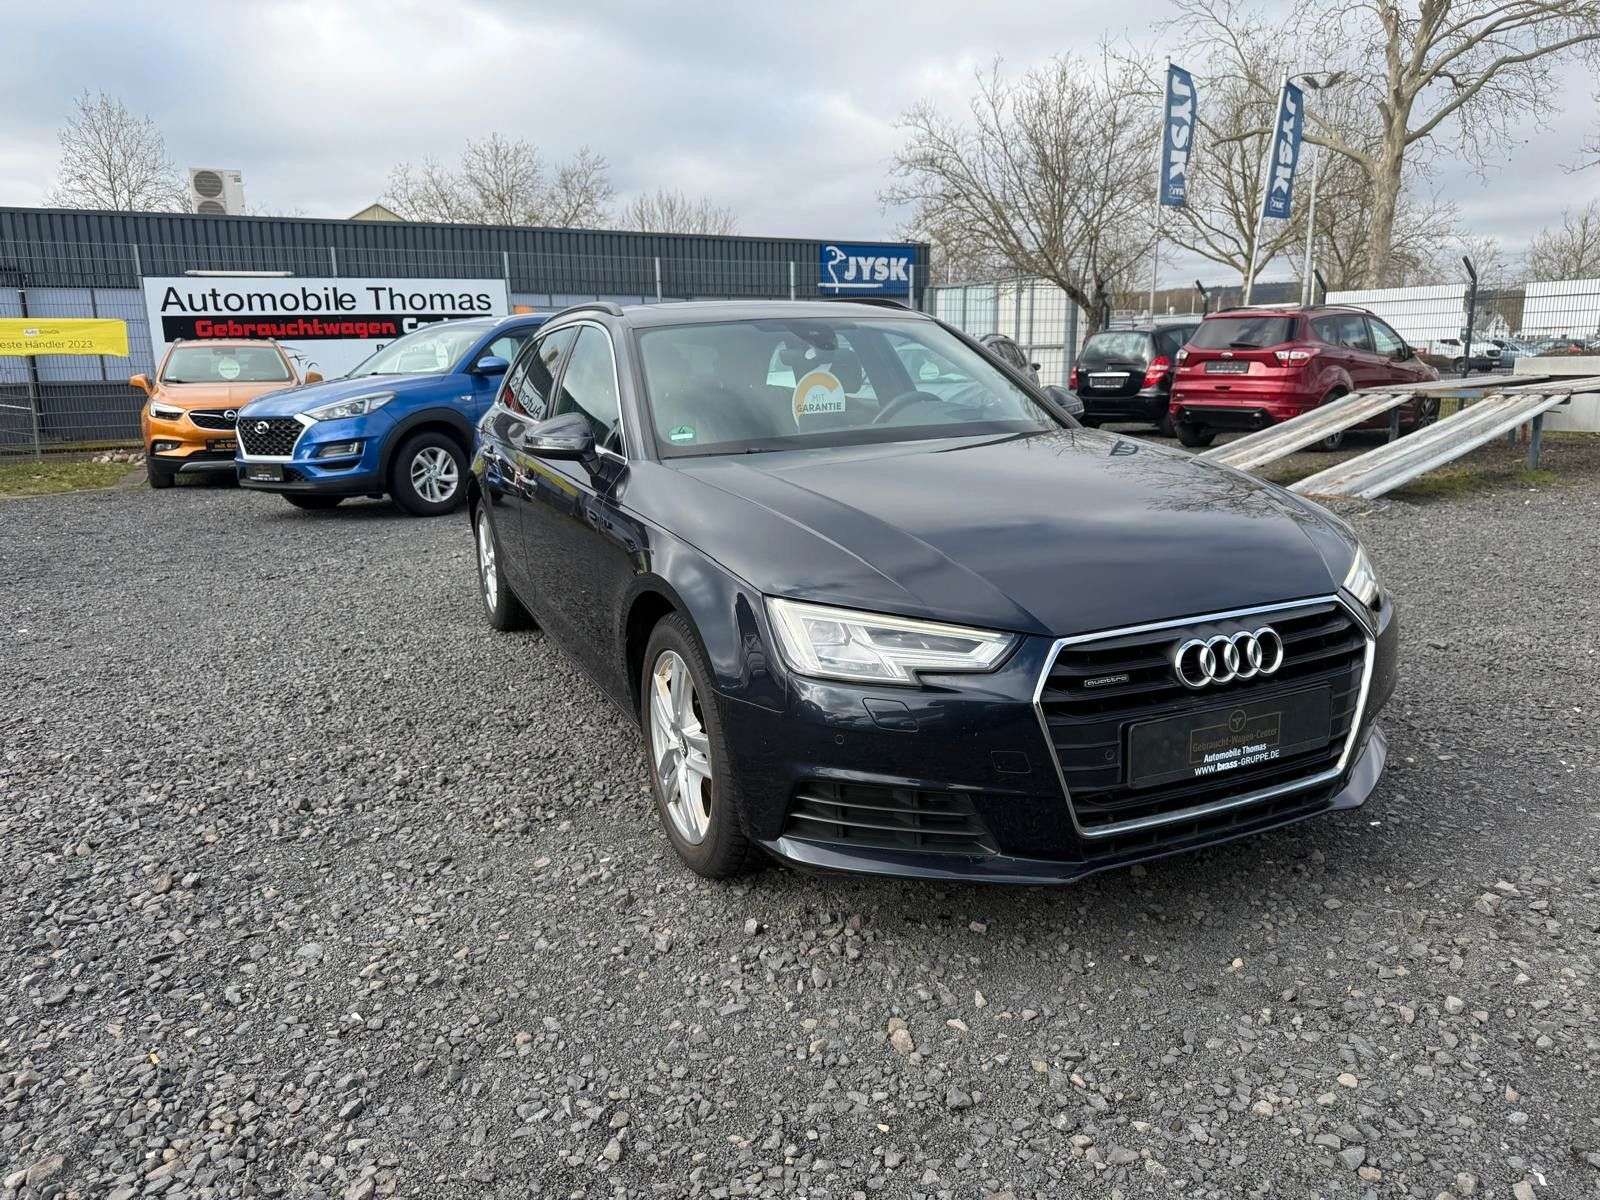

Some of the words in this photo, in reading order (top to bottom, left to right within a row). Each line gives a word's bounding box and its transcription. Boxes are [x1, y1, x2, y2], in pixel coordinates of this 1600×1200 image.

[1169, 74, 1193, 180] JYSK
[1272, 91, 1297, 194] JYSK
[844, 257, 909, 281] JYSK
[160, 286, 357, 312] Automobile
[366, 287, 492, 311] Thomas
[195, 319, 397, 339] Gebrauchtwagen
[68, 340, 94, 349] 2023
[796, 402, 842, 412] GARANTIE
[1087, 676, 1127, 686] quattro
[1194, 750, 1280, 776] WWW.brass-GRUPPE.DE
[1204, 747, 1241, 763] Automobile
[1242, 743, 1267, 755] Thomas
